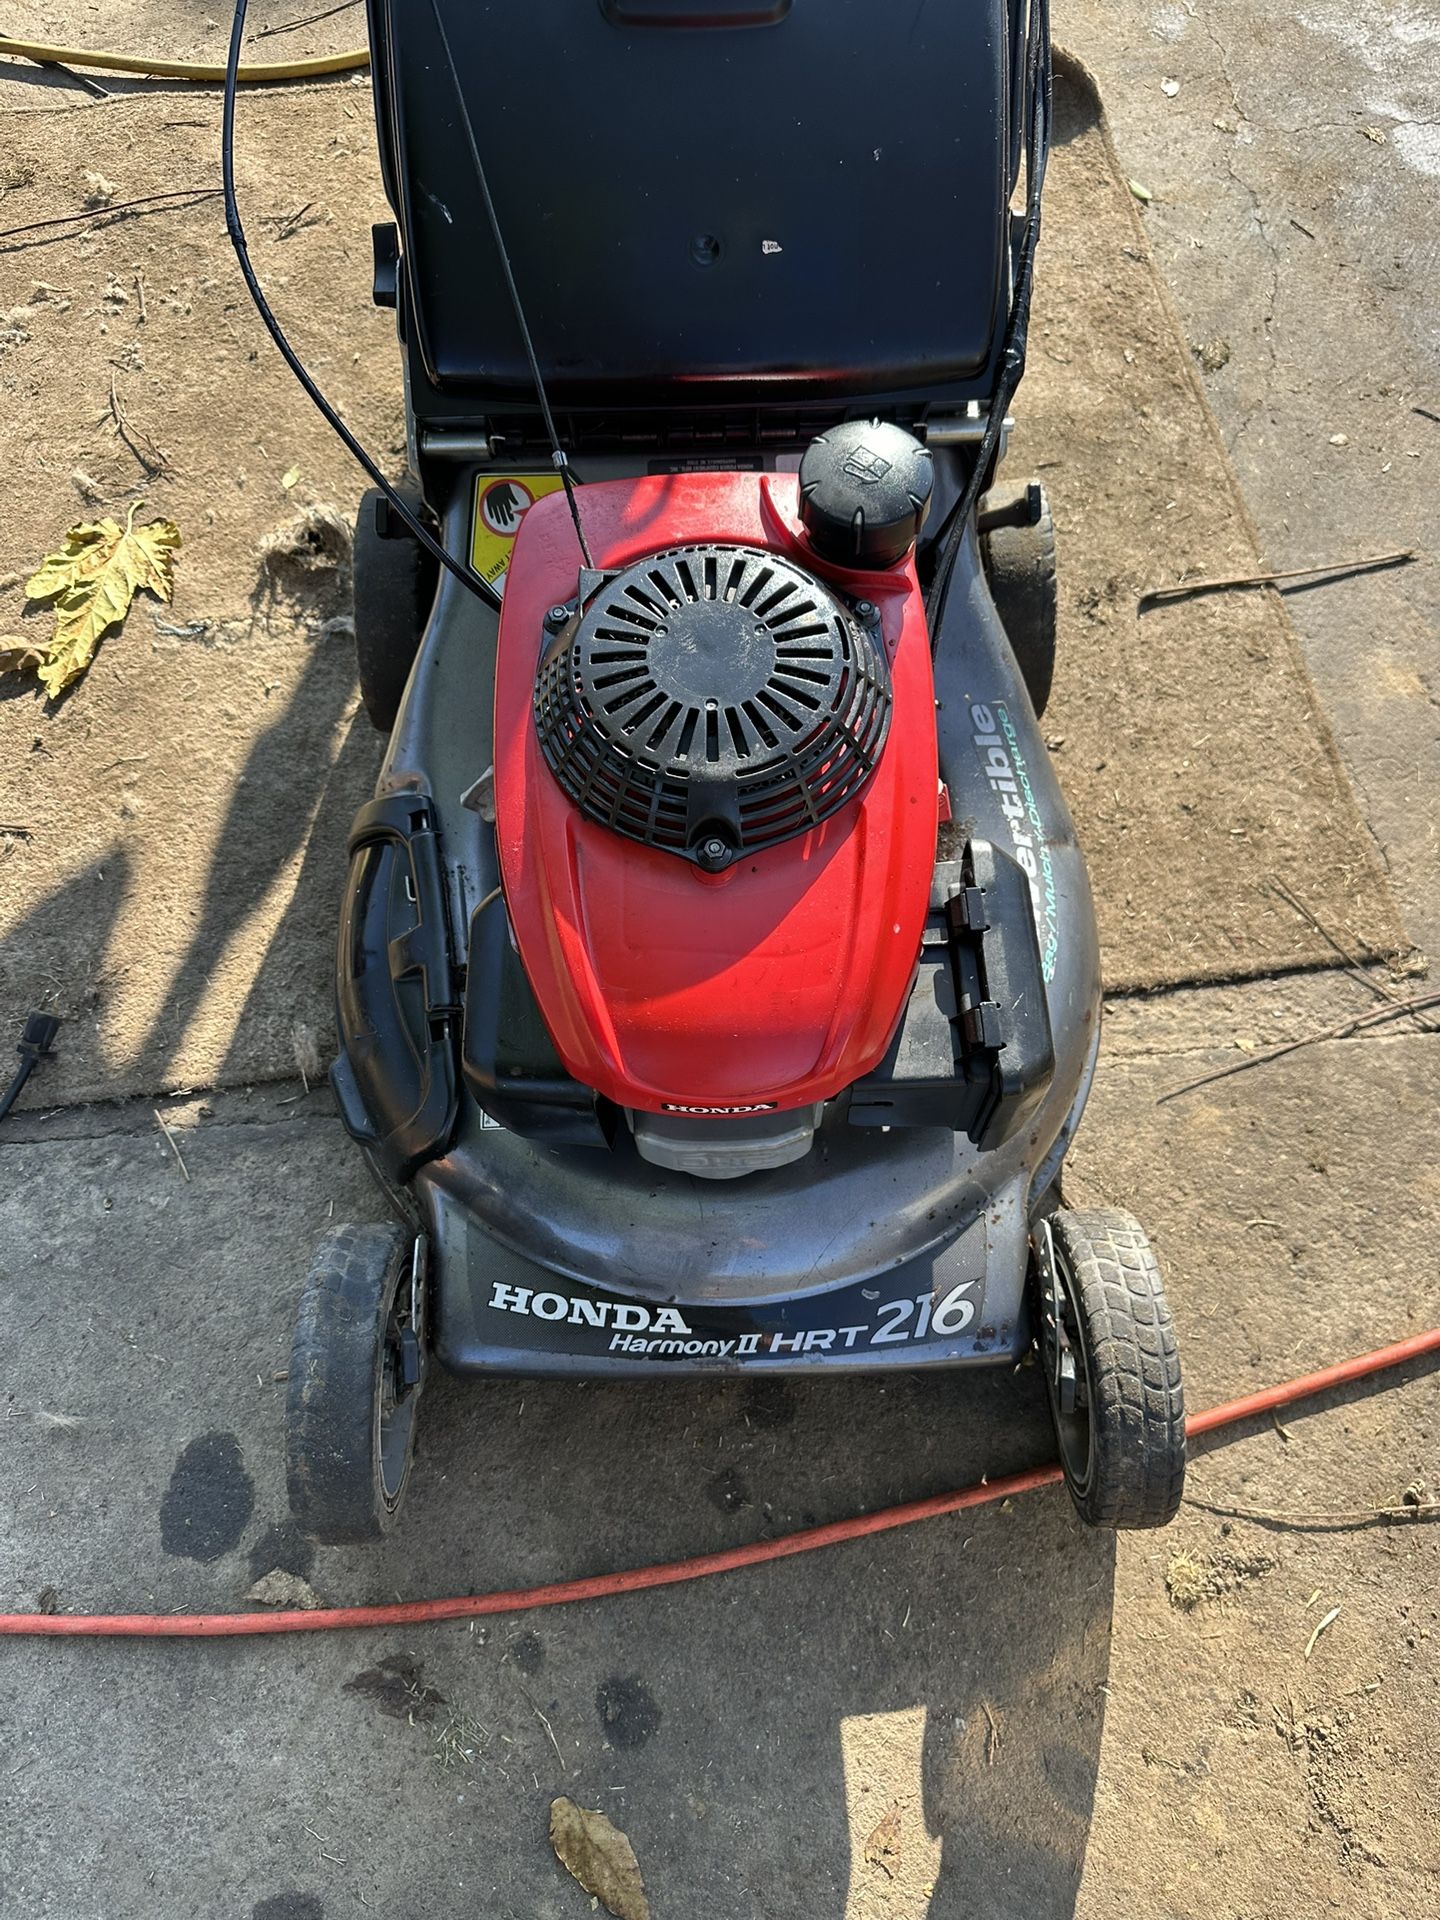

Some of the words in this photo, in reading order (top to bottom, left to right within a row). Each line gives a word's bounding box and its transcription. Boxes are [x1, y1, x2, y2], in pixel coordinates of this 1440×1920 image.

[666, 1103, 774, 1114] HONDA
[488, 1281, 692, 1334] HONDA
[608, 1333, 736, 1357] Harmony
[769, 1325, 869, 1353] HRT
[870, 1279, 978, 1344] 216
